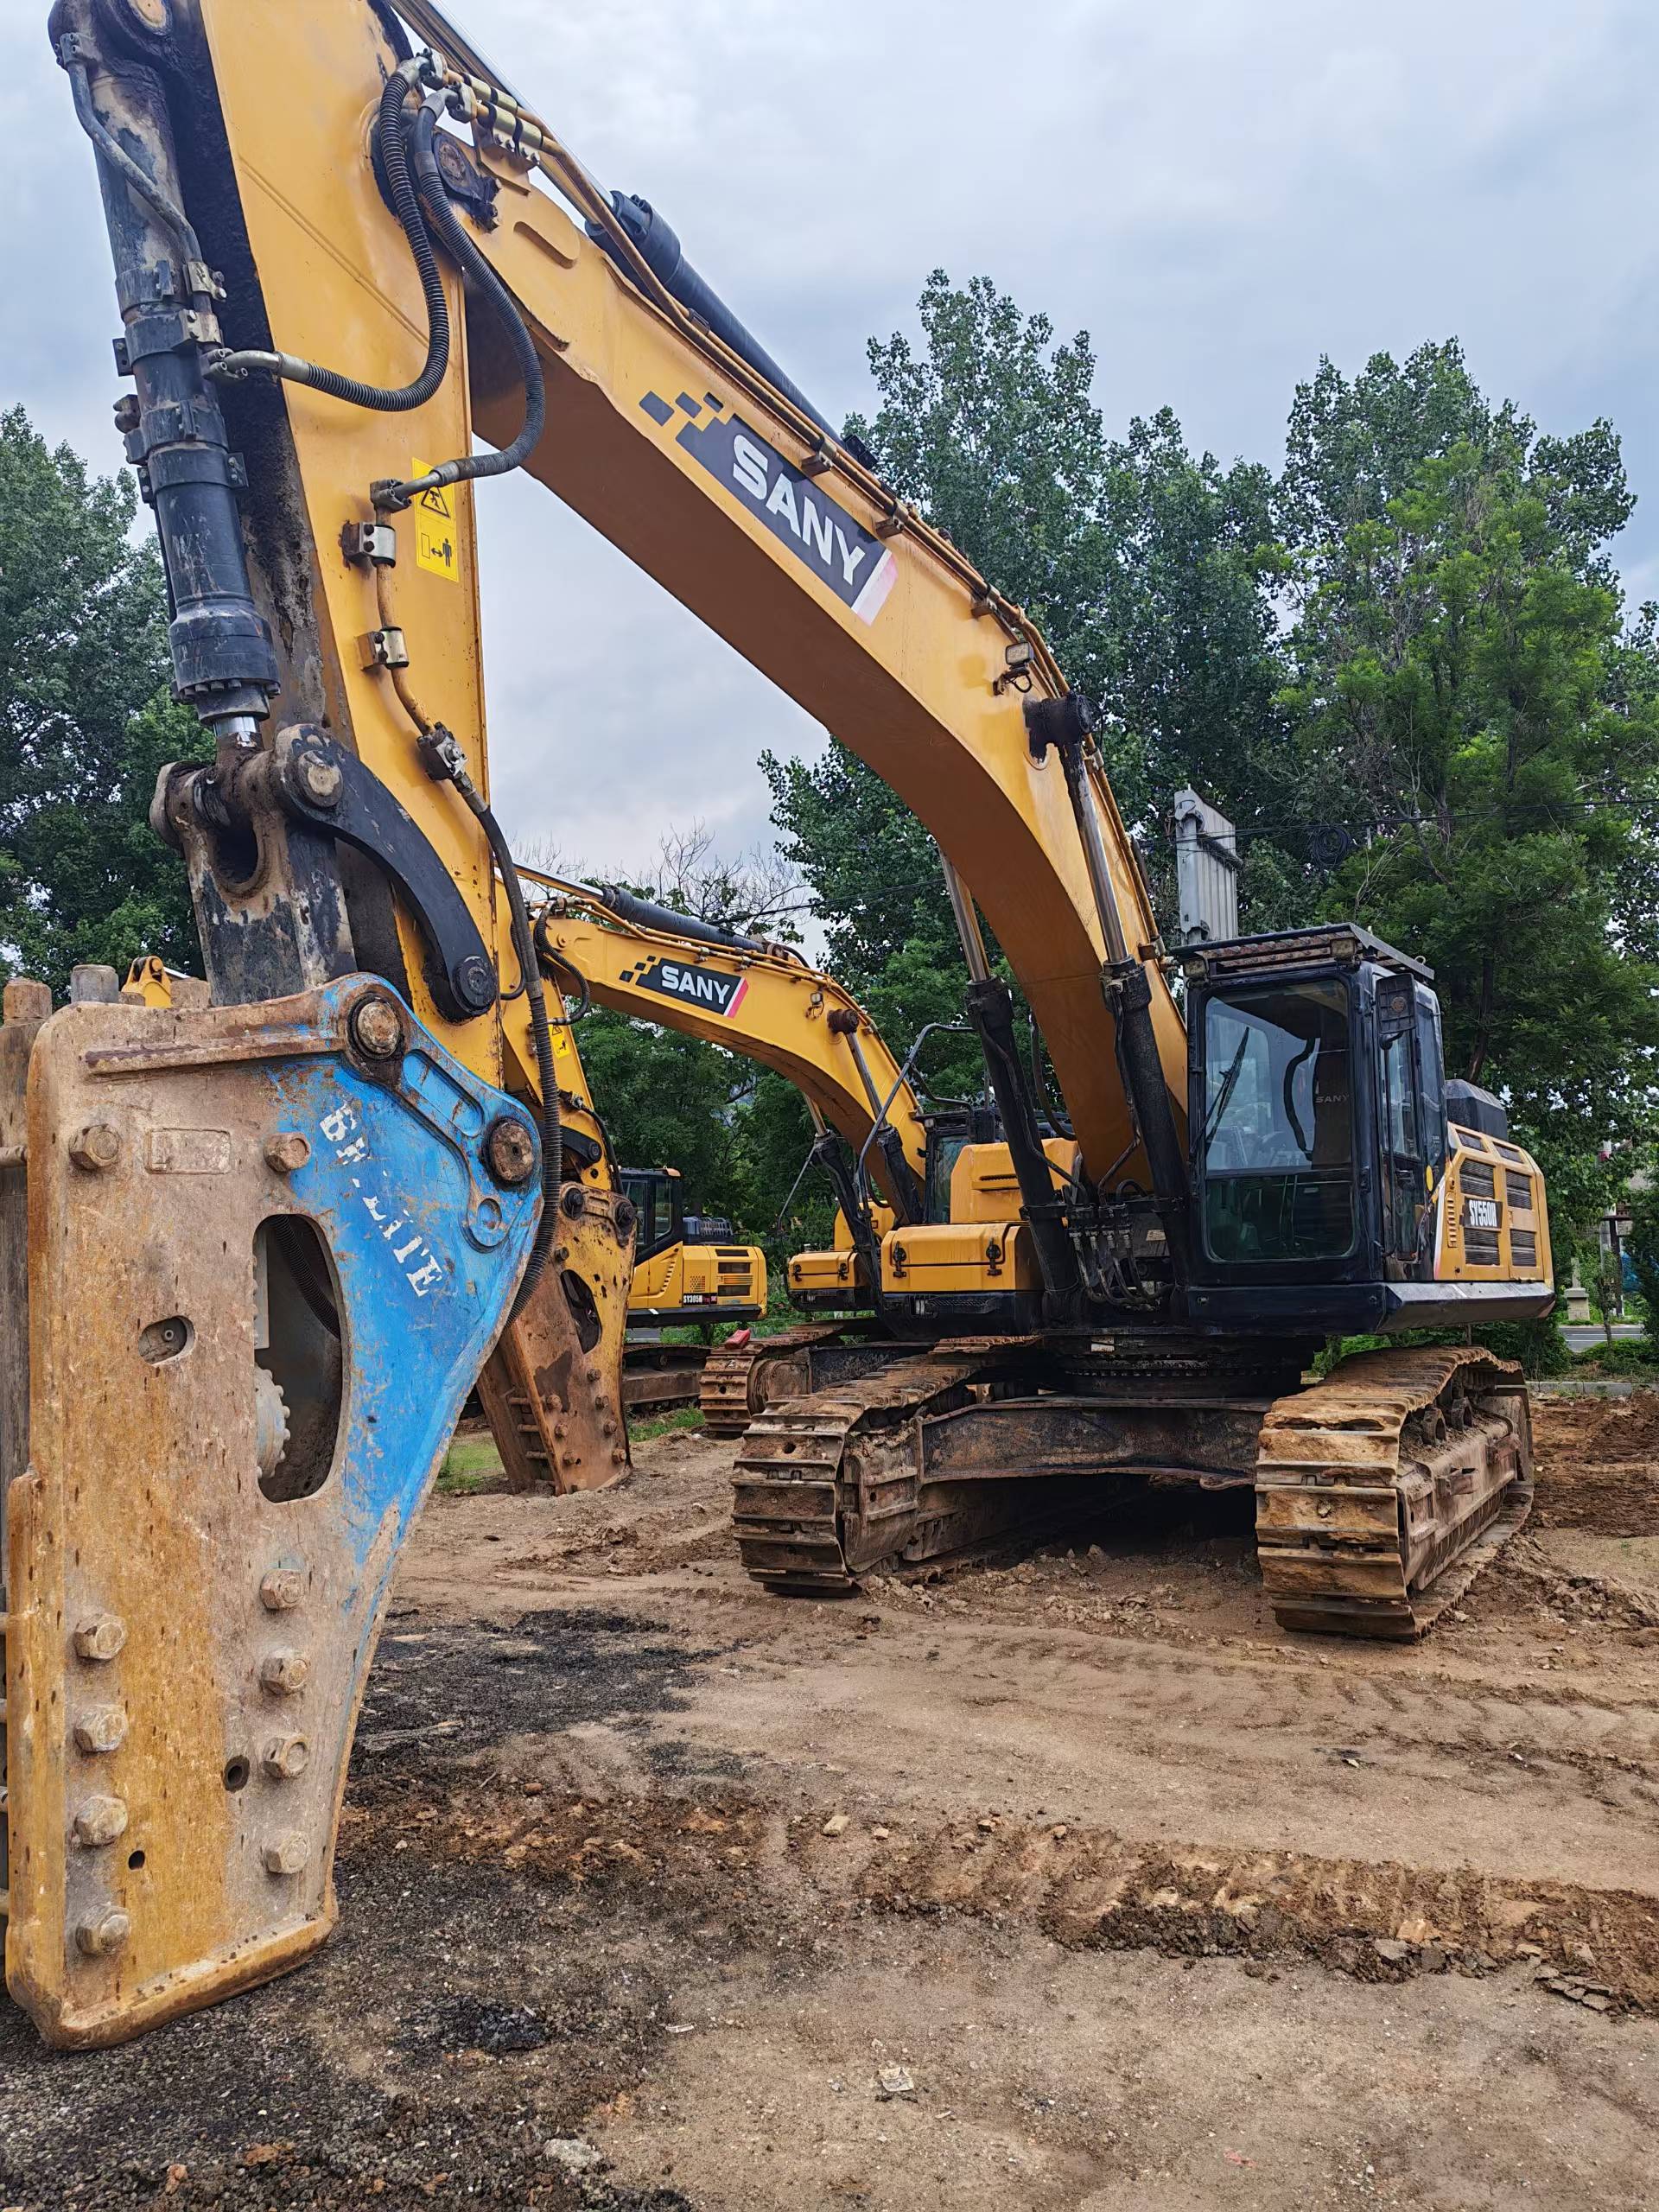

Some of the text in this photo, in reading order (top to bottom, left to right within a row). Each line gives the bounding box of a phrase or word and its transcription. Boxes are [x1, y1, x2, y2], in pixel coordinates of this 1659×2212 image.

[733, 435, 866, 587] SANY
[661, 965, 730, 1005] SANY
[1315, 1094, 1350, 1103] SANY
